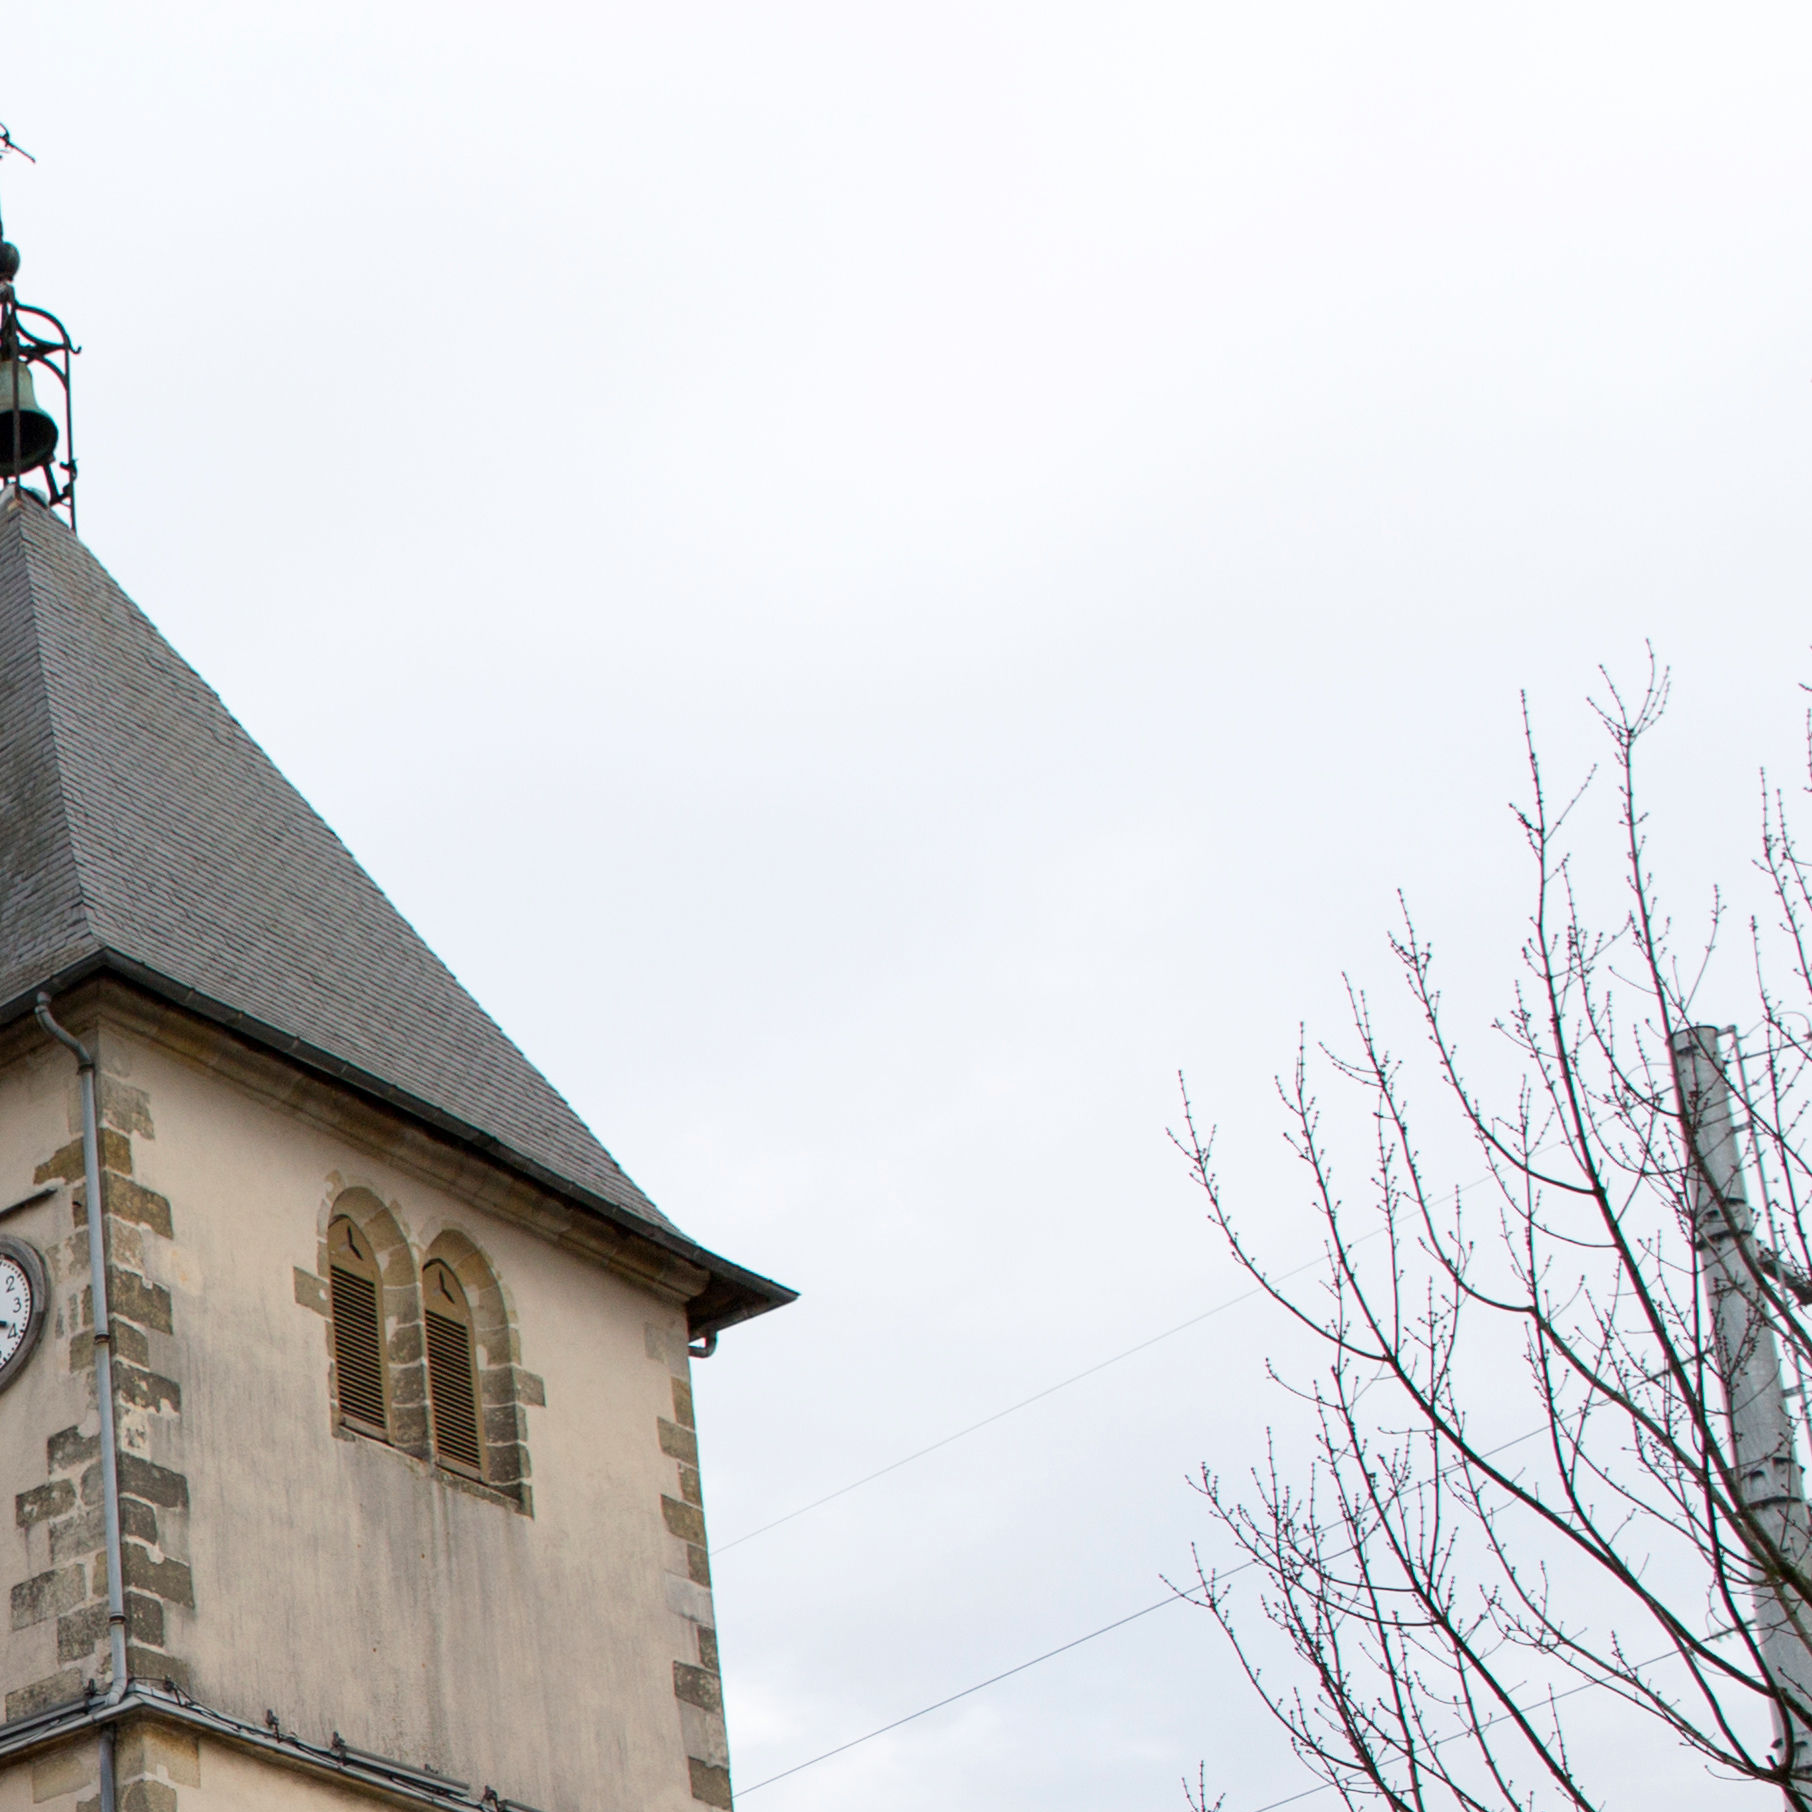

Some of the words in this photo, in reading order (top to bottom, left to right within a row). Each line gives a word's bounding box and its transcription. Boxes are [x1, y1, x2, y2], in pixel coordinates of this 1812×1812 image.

[6, 1275, 15, 1293] 2
[13, 1297, 22, 1313] 3
[7, 1322, 17, 1339] 4
